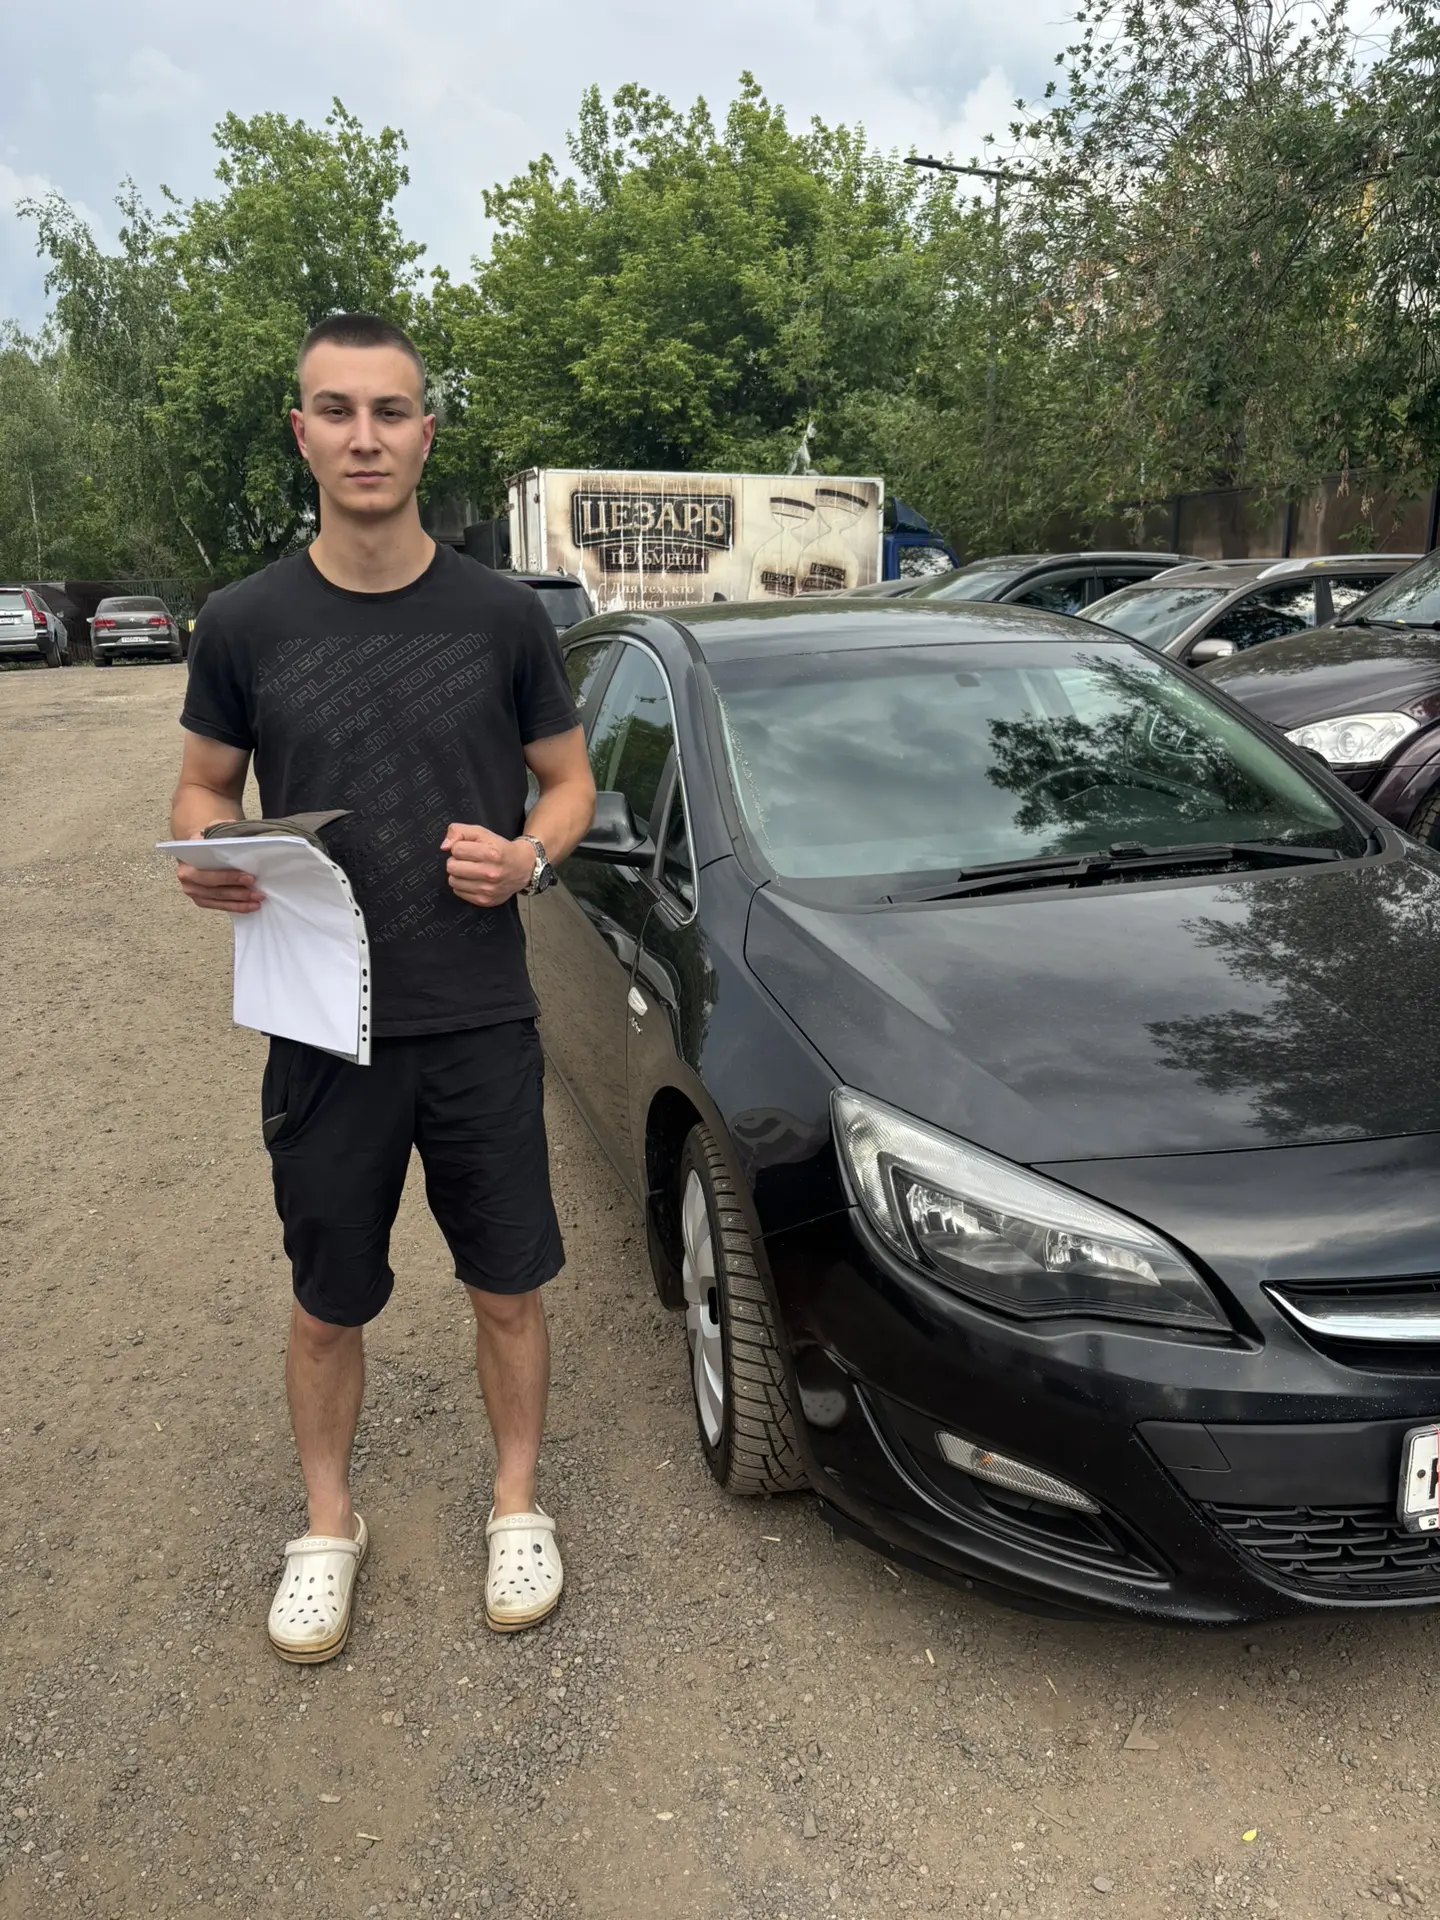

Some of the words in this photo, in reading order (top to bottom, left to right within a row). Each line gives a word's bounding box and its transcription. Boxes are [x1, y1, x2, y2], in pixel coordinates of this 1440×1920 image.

[581, 500, 725, 537] ЦЕЗАРЬ
[611, 551, 699, 566] ПЕЛЬМЕНИ
[611, 582, 638, 594] Для
[671, 585, 694, 594] кто
